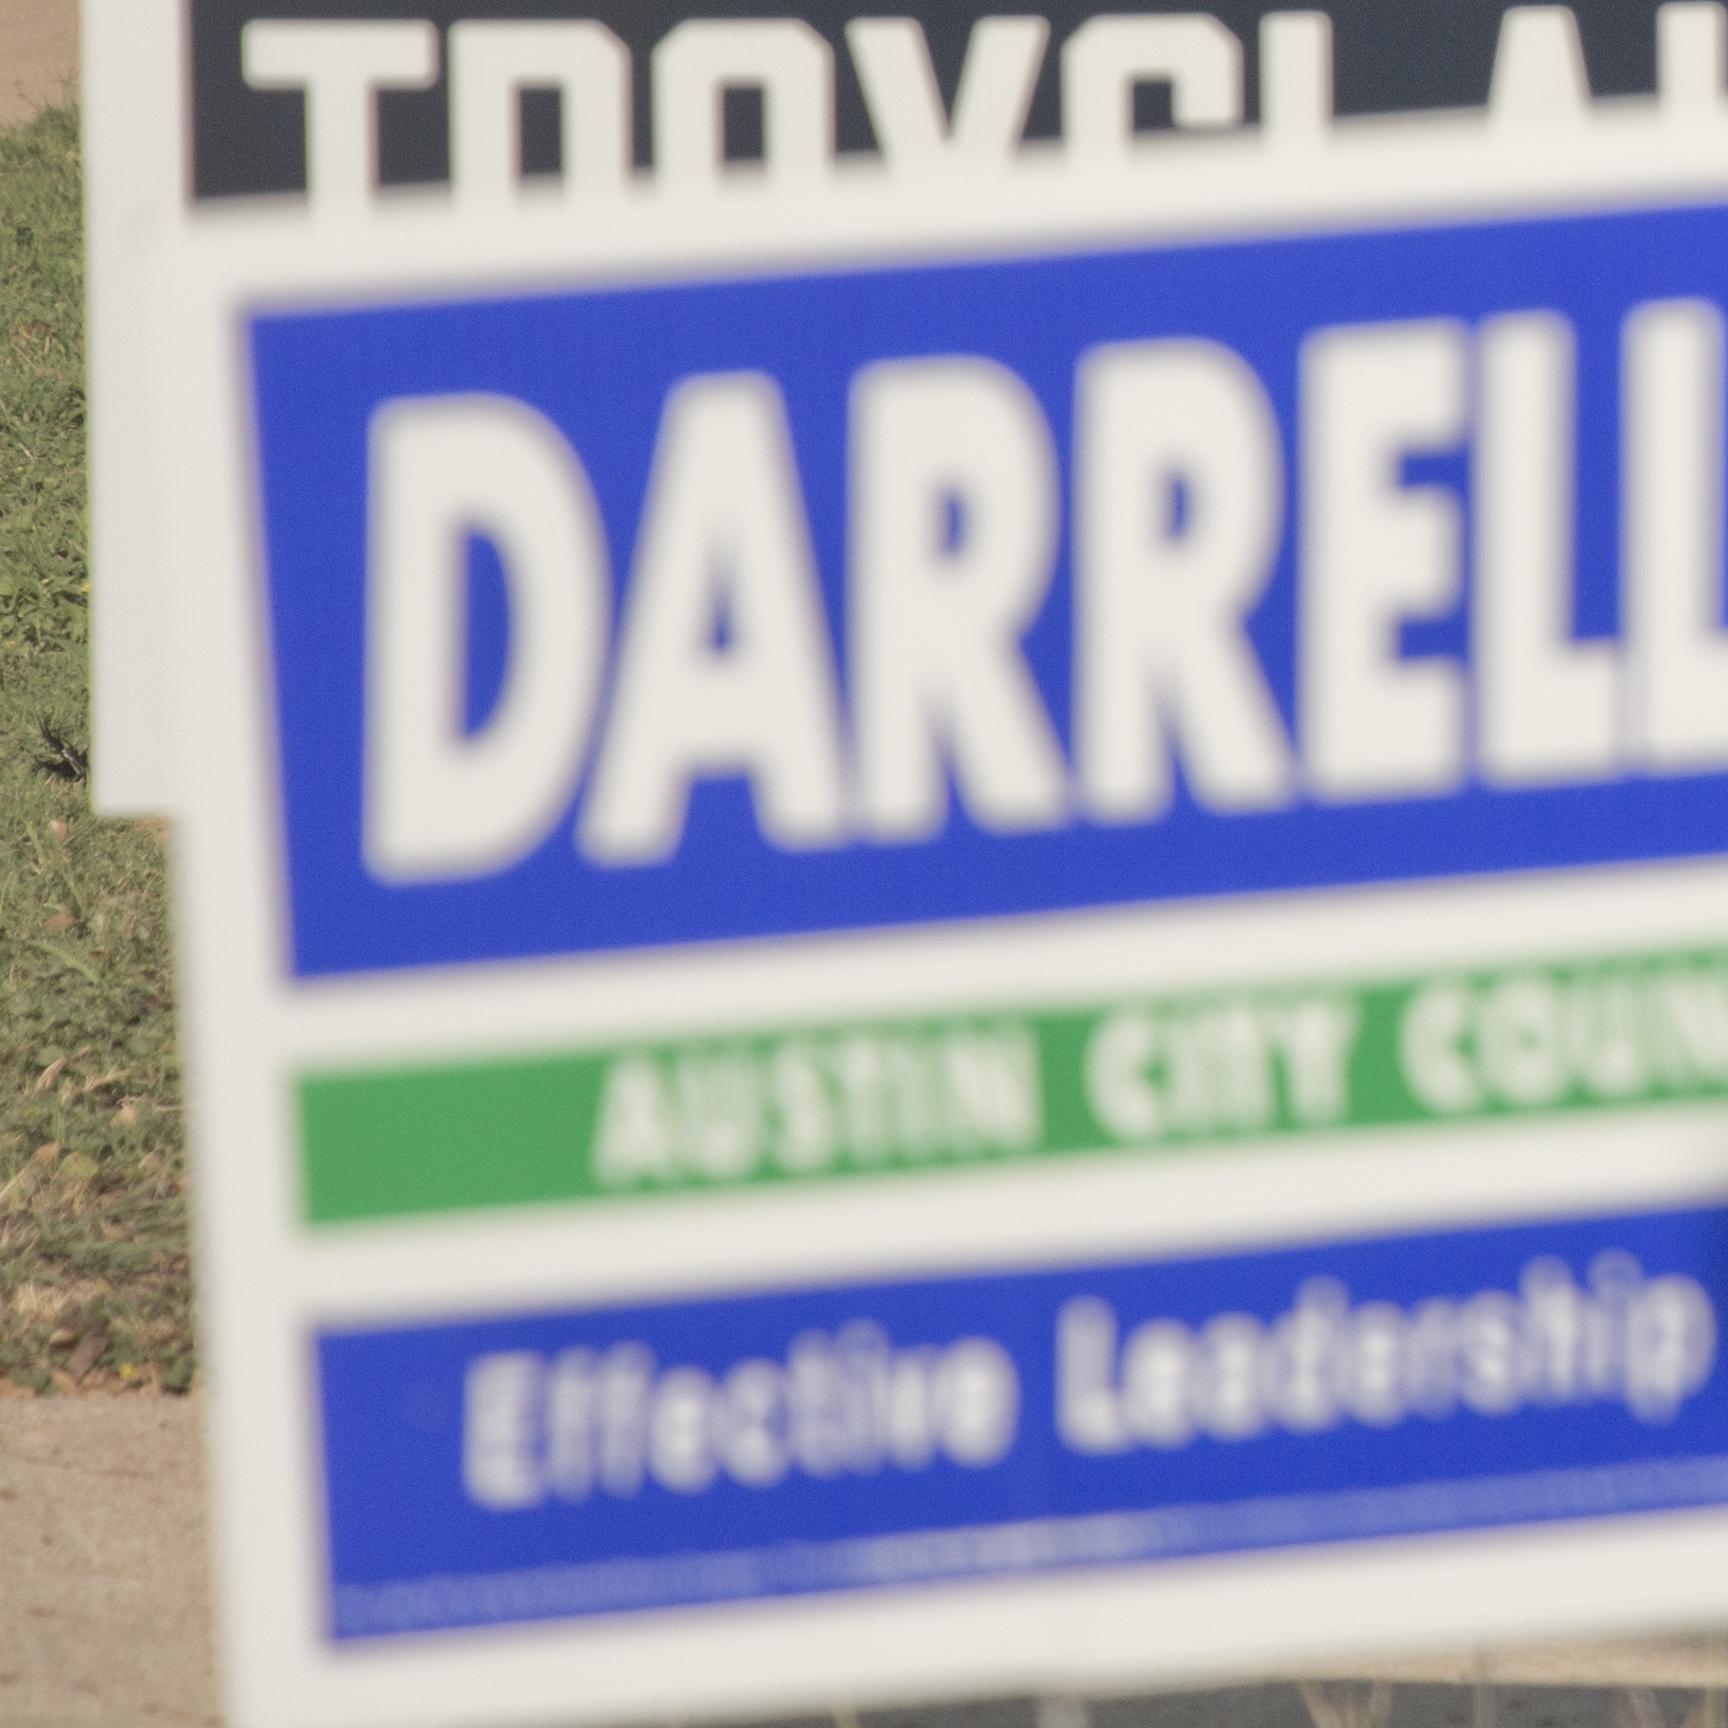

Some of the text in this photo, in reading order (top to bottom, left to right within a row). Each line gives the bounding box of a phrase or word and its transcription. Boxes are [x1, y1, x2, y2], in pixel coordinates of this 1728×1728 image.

[591, 1018, 1048, 1194] AUSTIN
[1085, 989, 1360, 1144] CITY
[459, 1317, 1022, 1514] Effective
[1053, 1246, 1720, 1457] Leadership
